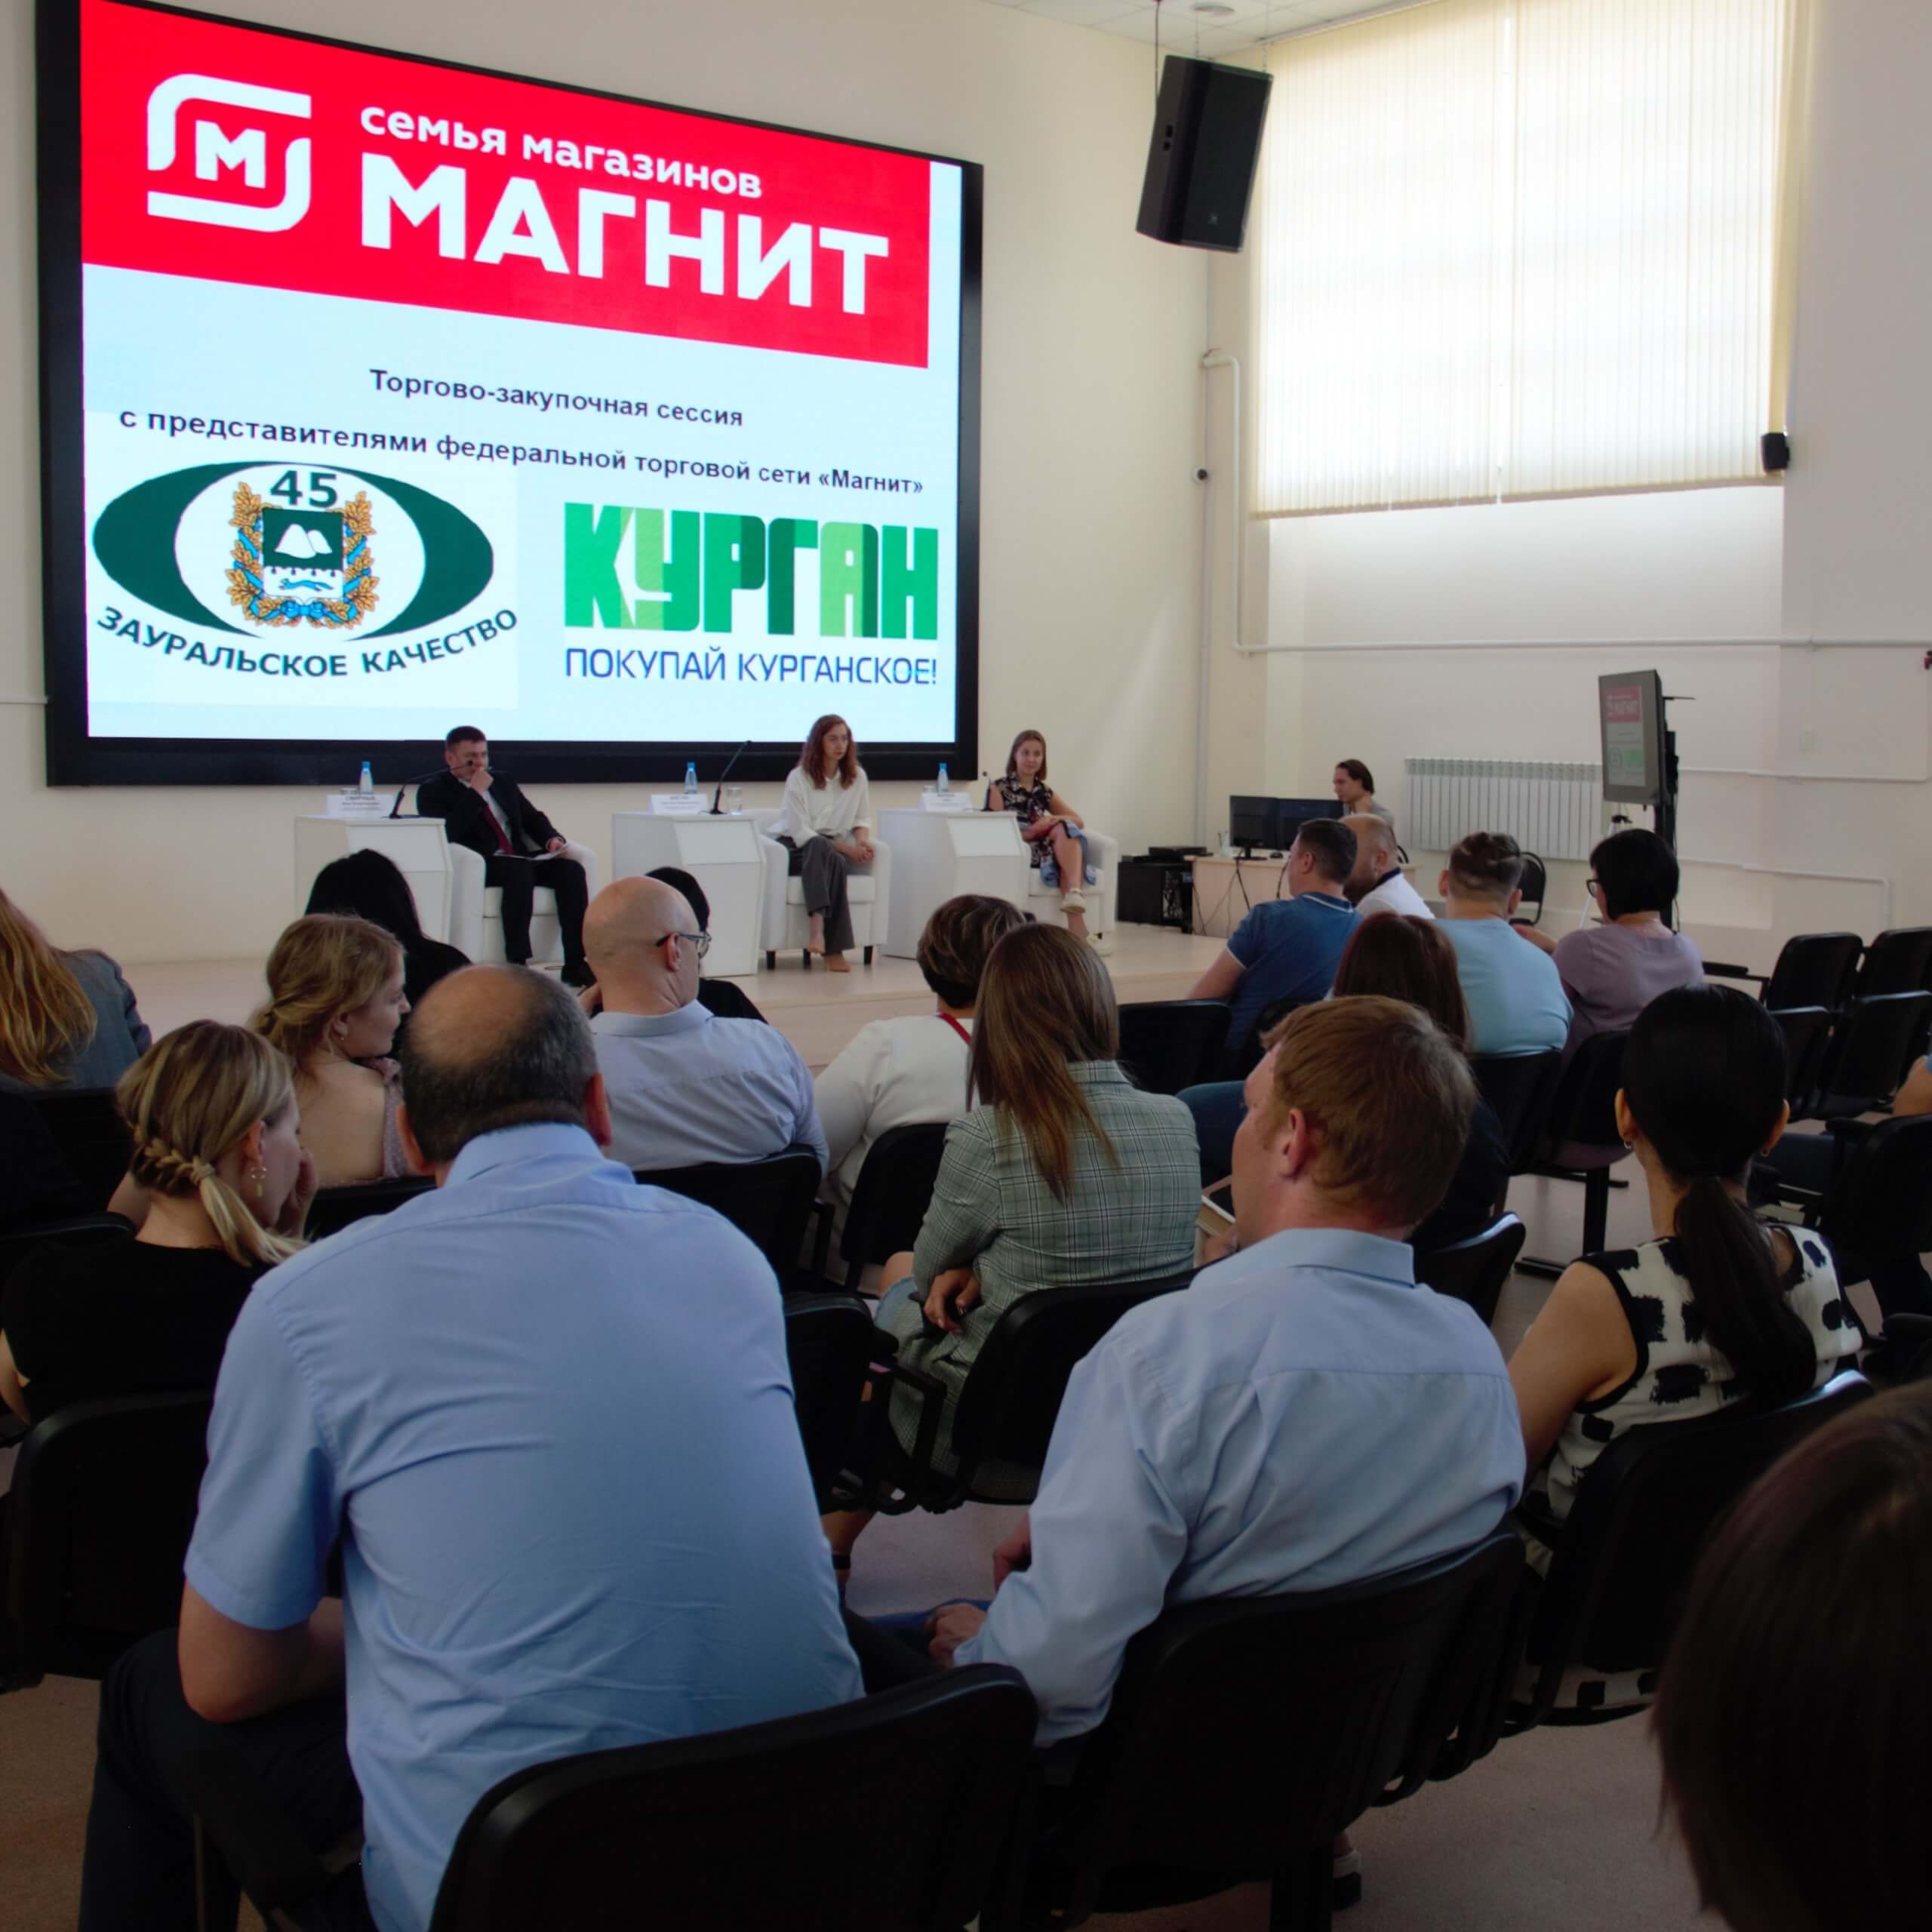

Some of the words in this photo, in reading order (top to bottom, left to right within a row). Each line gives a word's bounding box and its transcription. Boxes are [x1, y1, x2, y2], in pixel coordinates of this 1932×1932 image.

[195, 120, 266, 189] М
[361, 106, 506, 155] семья
[523, 134, 762, 198] магазинов
[361, 152, 889, 315] МАГНИТ
[368, 368, 648, 417] Торгово-закупочная
[657, 403, 743, 426] сессия
[118, 411, 137, 428] с
[146, 412, 426, 453] представителями
[435, 434, 626, 469] федеральной
[634, 456, 749, 480] торговой
[758, 467, 810, 485] сети
[818, 468, 923, 494] «Магнит»
[269, 469, 337, 509] 45
[563, 501, 940, 641] КУРГАН
[96, 606, 347, 677] ЗАУРАЛЬСКОЕ
[361, 609, 517, 673] КАЧЕСТВО
[564, 645, 726, 681] ПОКУПАЙ
[737, 652, 937, 685] КУРГАНСКОЕ!
